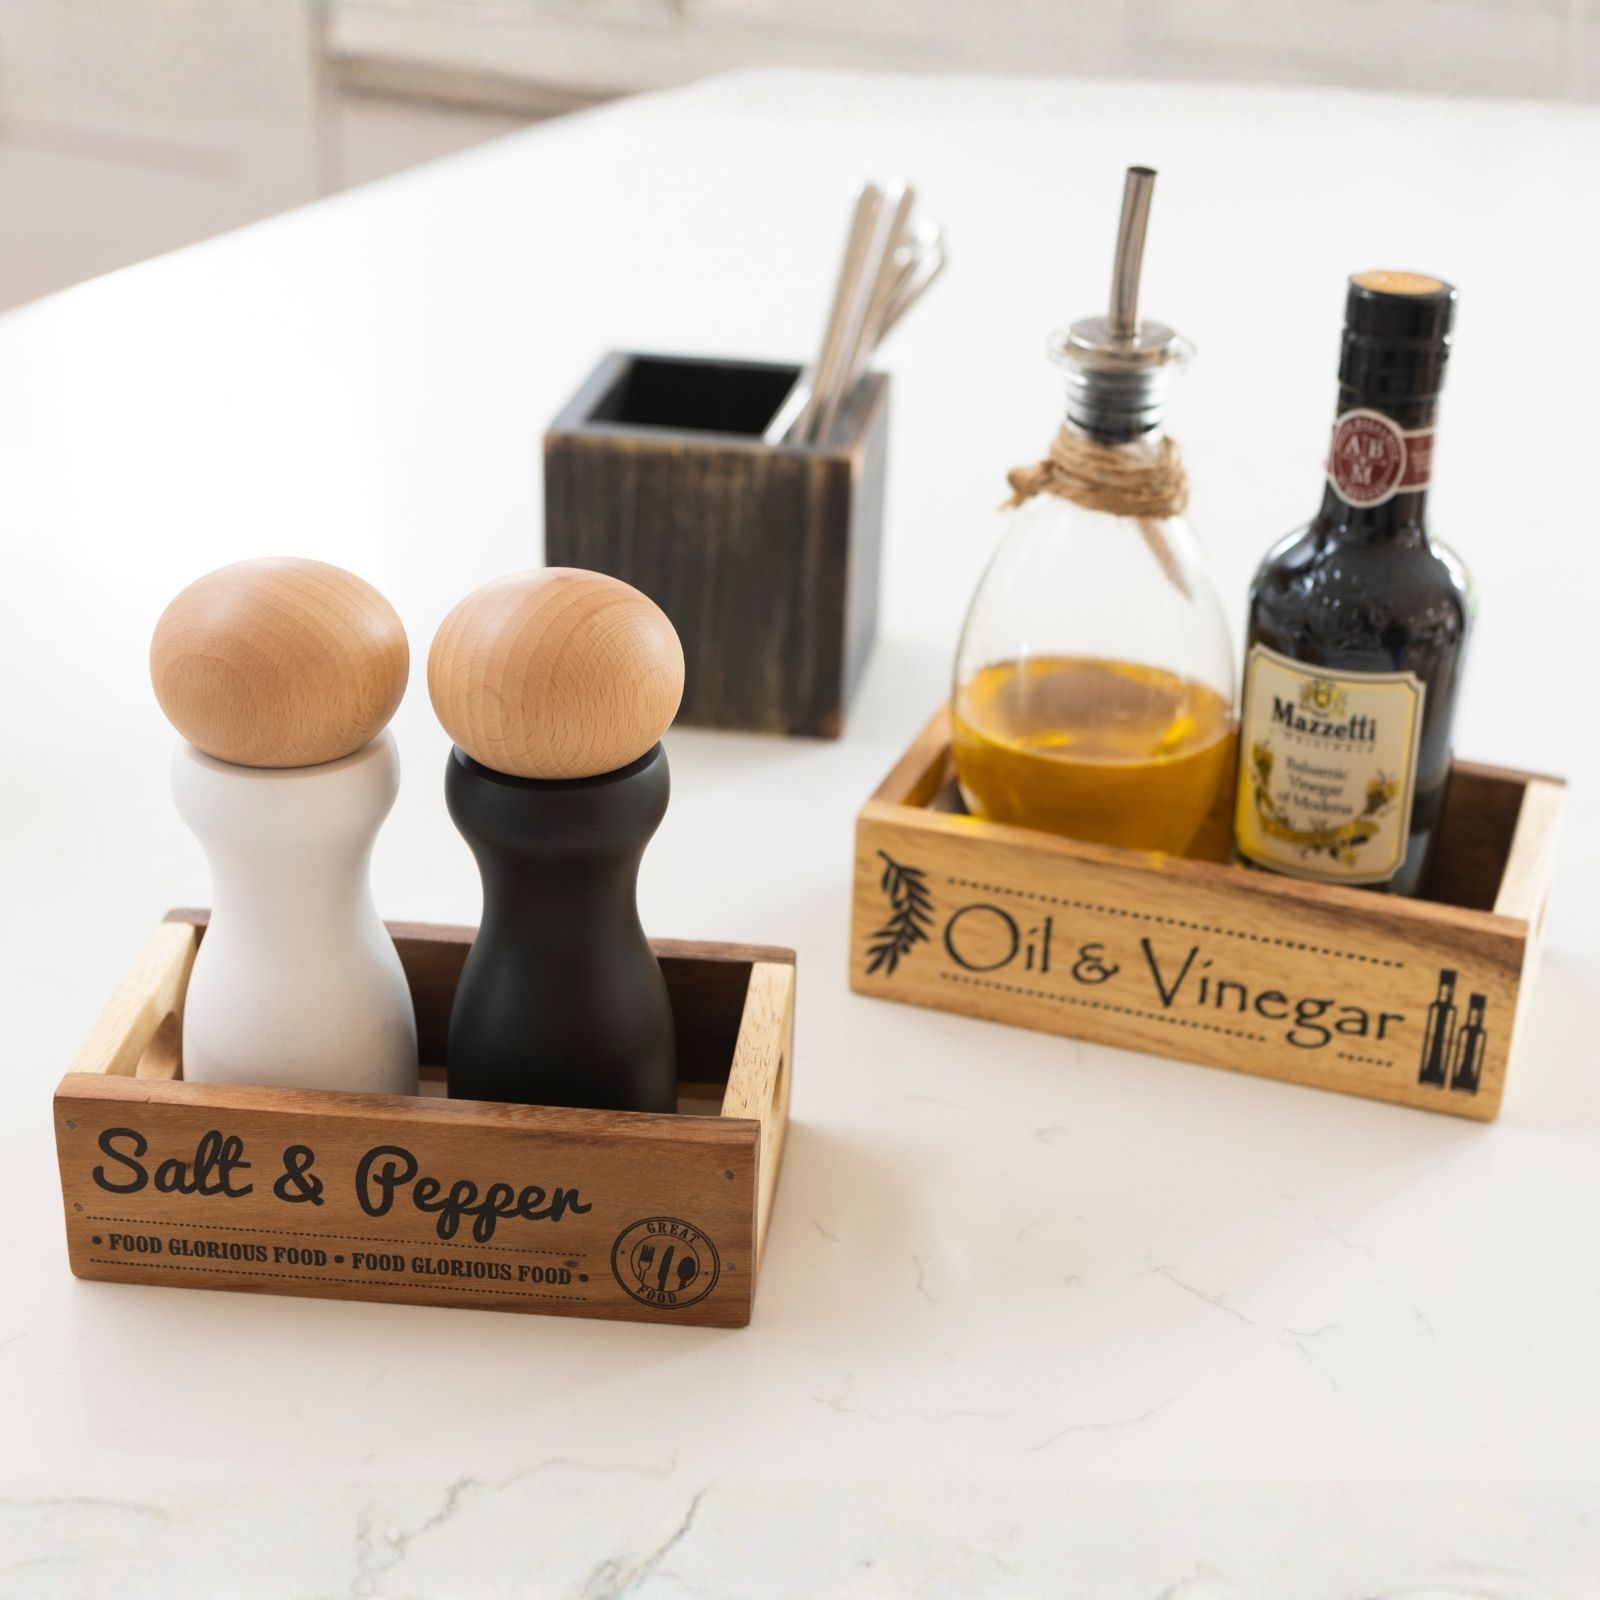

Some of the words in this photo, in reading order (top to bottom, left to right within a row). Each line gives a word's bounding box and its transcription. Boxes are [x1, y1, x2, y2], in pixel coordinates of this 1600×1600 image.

[1272, 697, 1377, 742] Mazzetti
[943, 903, 1053, 973] Oil
[1072, 943, 1120, 985] &
[1141, 937, 1405, 1049] Vinegar
[92, 1127, 253, 1197] Salt
[273, 1145, 324, 1206] &
[356, 1145, 592, 1243] Pepper
[646, 1222, 700, 1245] GREAT
[109, 1233, 163, 1255] FOOD
[168, 1238, 269, 1263] GLORIOUS
[274, 1245, 328, 1266] FOOD
[352, 1250, 406, 1272] FOOD
[411, 1255, 513, 1281] GLORIOUS
[518, 1264, 572, 1286] FOOD
[636, 1284, 677, 1303] FOOD
